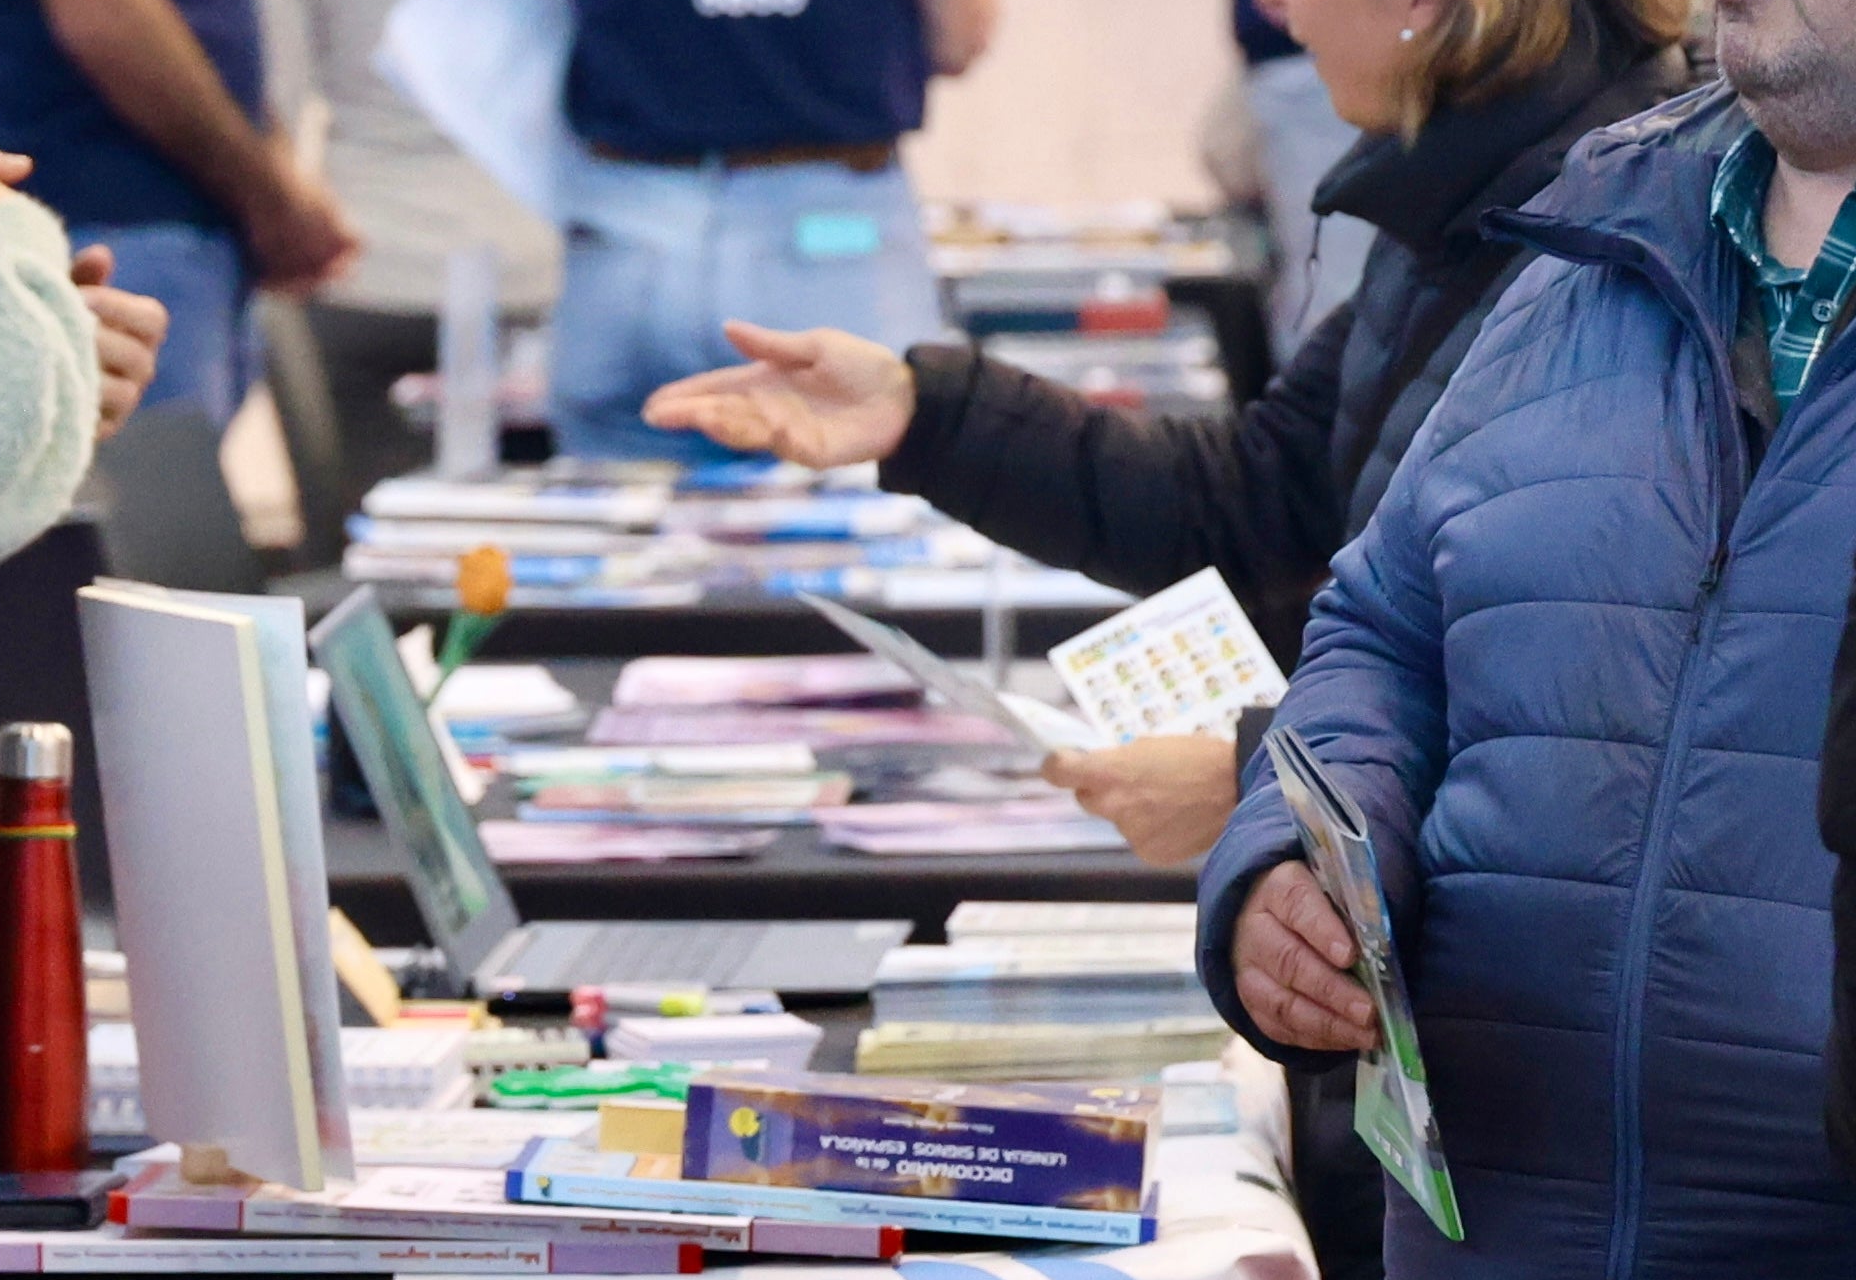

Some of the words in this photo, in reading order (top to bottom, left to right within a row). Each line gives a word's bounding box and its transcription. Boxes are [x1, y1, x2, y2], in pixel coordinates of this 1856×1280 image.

[912, 1141, 976, 1161] SIGNOS
[977, 1146, 1000, 1163] DE
[896, 1159, 1014, 1184] DICCIONARIO
